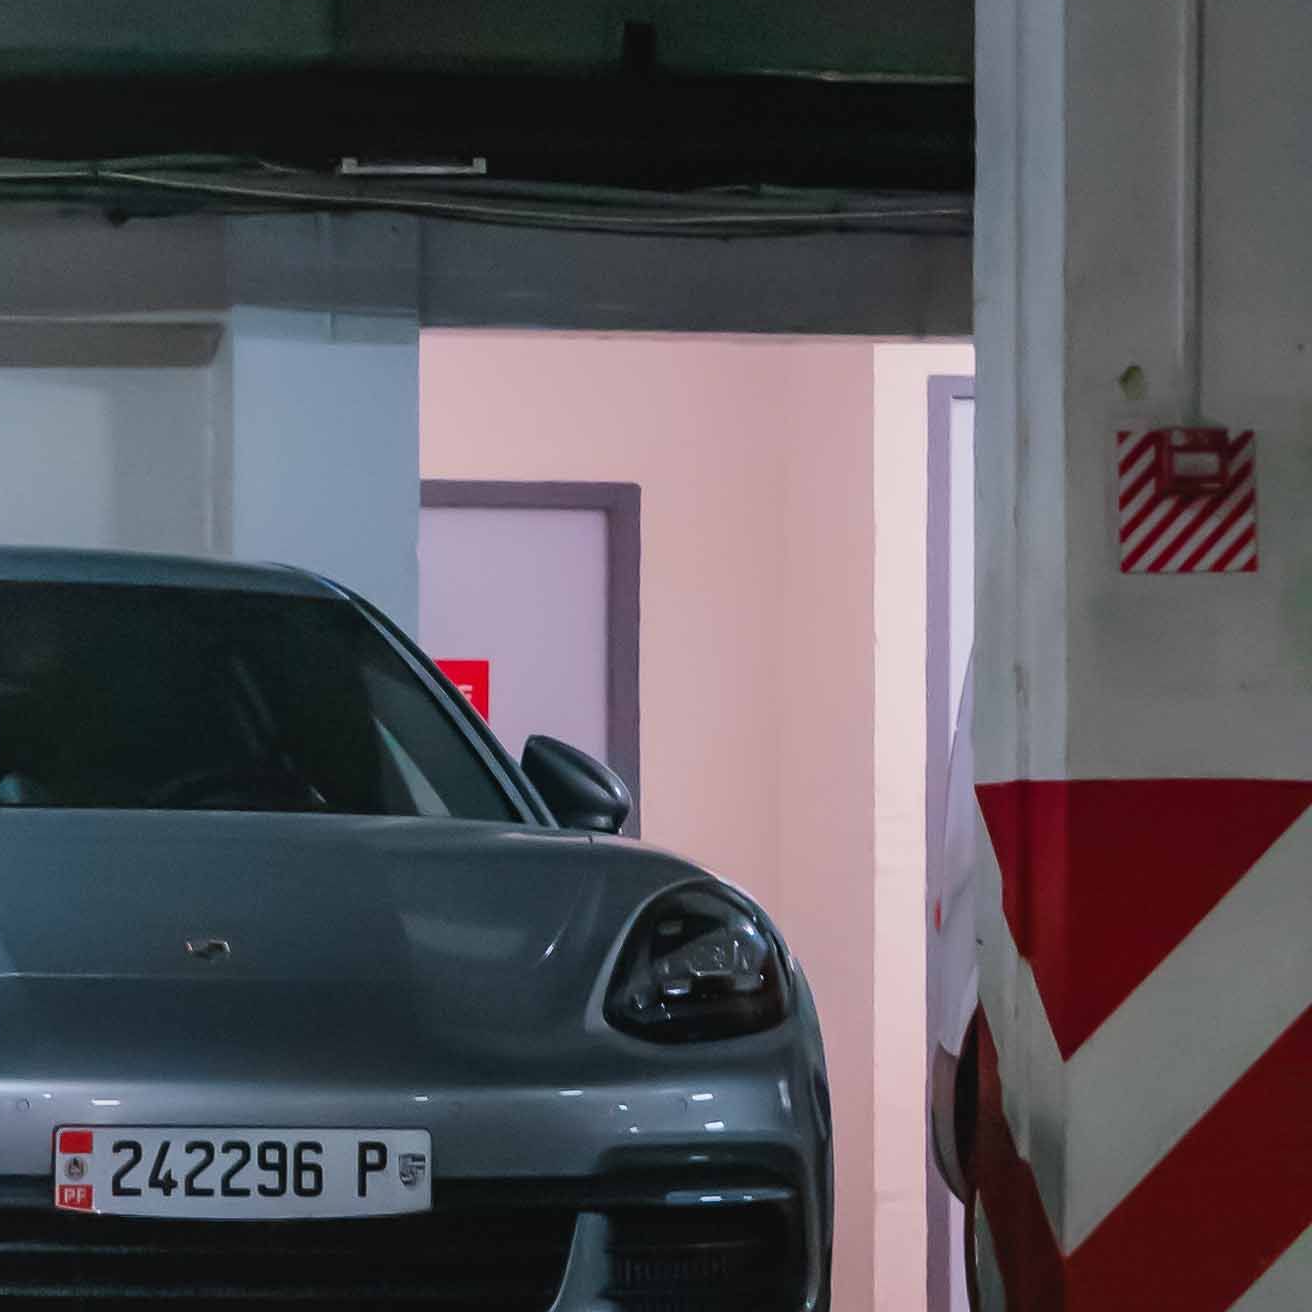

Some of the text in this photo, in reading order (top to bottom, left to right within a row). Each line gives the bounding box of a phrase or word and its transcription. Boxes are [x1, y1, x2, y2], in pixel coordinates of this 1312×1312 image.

[111, 1140, 388, 1198] 242296 P
[63, 1187, 87, 1204] PF
